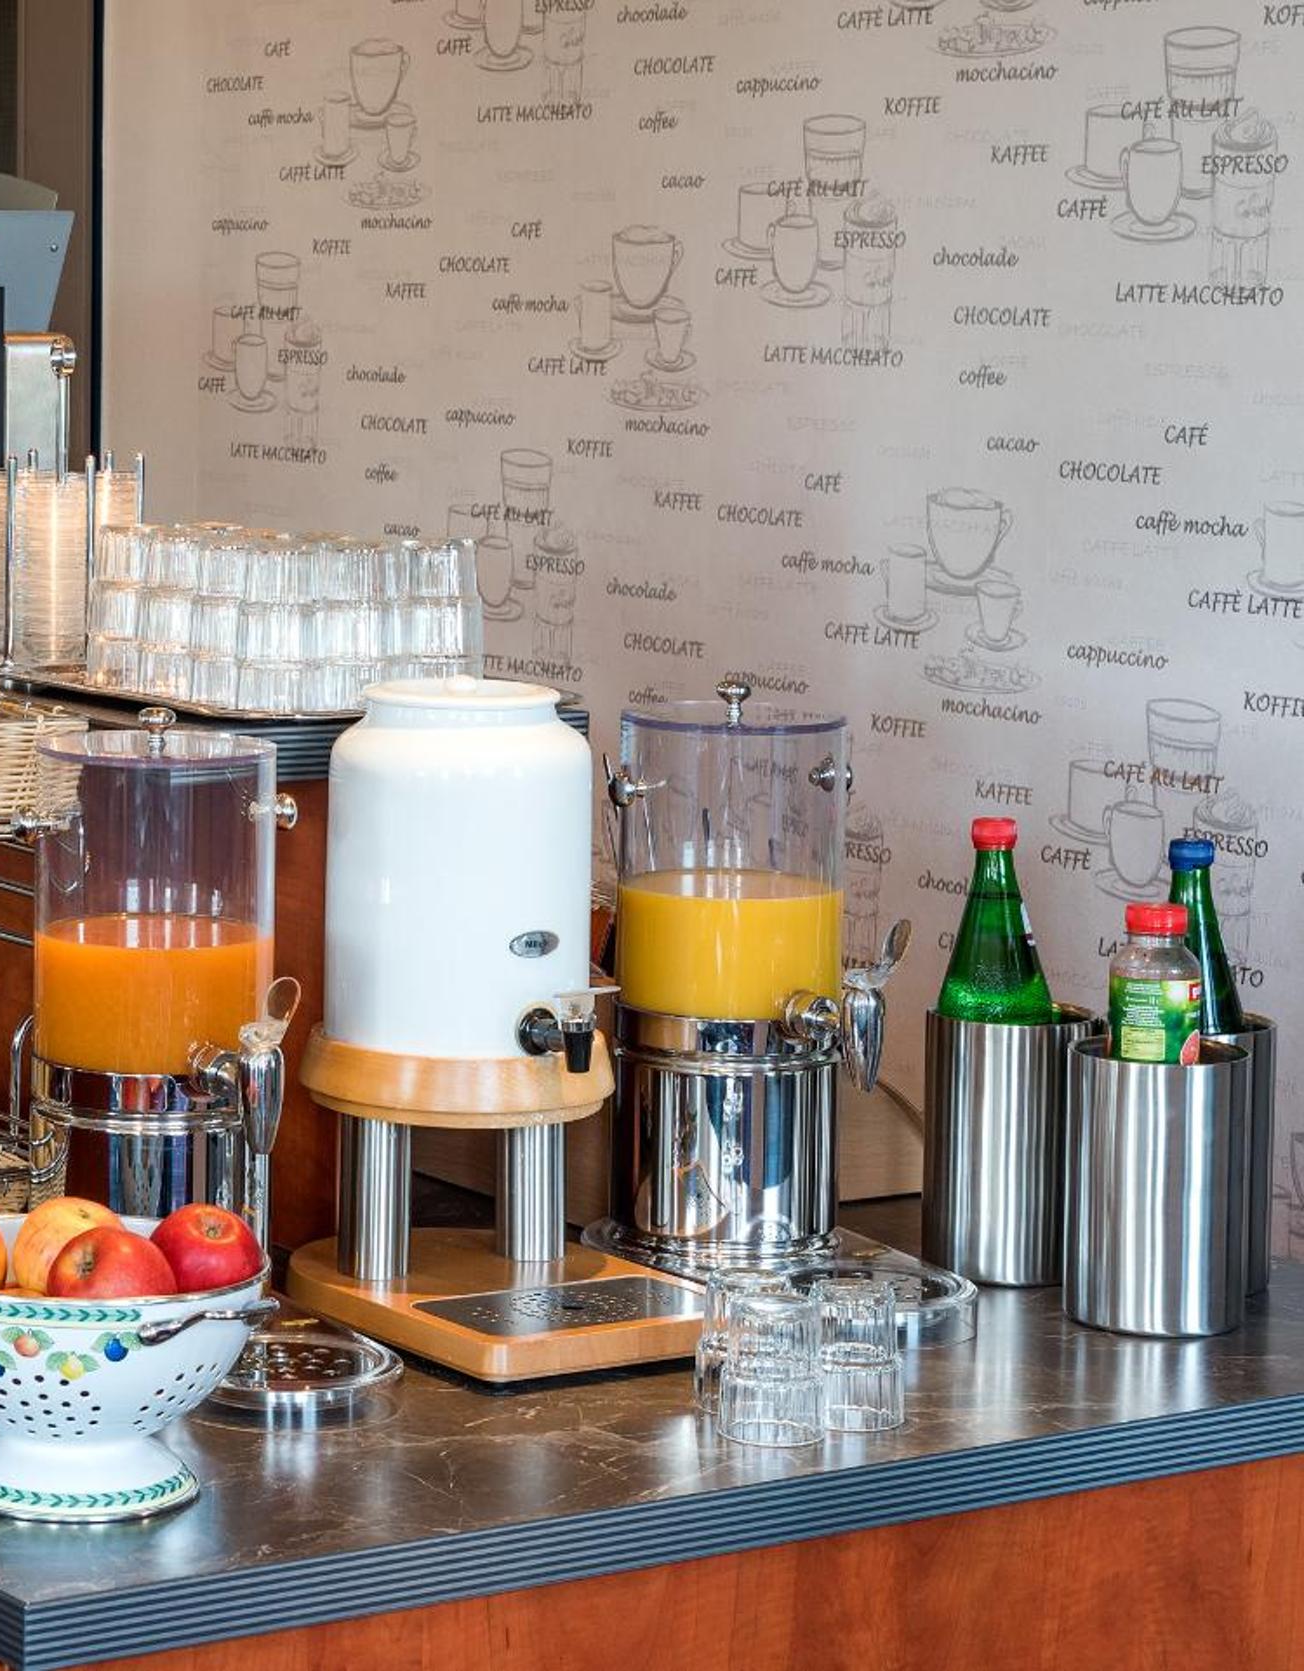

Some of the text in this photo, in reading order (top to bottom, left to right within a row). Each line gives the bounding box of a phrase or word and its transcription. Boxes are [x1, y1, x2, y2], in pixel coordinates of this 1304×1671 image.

[616, 3, 688, 23] chocolade
[887, 7, 934, 27] LATTE
[1264, 5, 1304, 26] KOF
[634, 56, 716, 75] CHOCOLATE
[955, 61, 1058, 83] mocchacino
[206, 76, 264, 93] CHOCOLATE
[736, 74, 821, 98] cappuccino
[477, 102, 593, 122] LATTE MACCHIATO
[884, 96, 941, 116] KOFFIE
[1121, 97, 1243, 120] CAFÉ AU LAIT
[276, 109, 314, 125] mocha
[638, 111, 679, 133] coffee
[990, 145, 1050, 165] KAFFEE
[1201, 154, 1289, 175] ESPRESSO
[313, 165, 346, 182] LATTE
[661, 174, 705, 189] cacao
[767, 178, 802, 198] CAFÉ
[834, 180, 869, 198] LAIT
[1056, 195, 1108, 219] CAFFÈ
[211, 218, 270, 237] cappuccino
[361, 214, 433, 231] mocchacino
[511, 219, 543, 239] CAFÉ
[312, 238, 352, 256] KOFFIE
[834, 230, 907, 249] ESPRESSO
[439, 256, 511, 274] CHOCOLATE
[933, 247, 1019, 268] chocolade
[386, 282, 427, 299] KAFFEE
[1115, 282, 1284, 306] LATTE MACCHIATO
[525, 295, 570, 312] mocha
[954, 305, 1052, 328] CHOCOLATE
[278, 348, 328, 366] ESPRESSO
[569, 357, 607, 376] LATTE
[764, 345, 904, 368] LATTE MACCHIATO
[346, 364, 407, 384] chocolade
[959, 364, 1007, 388] coffee
[361, 414, 428, 434] CHOCOLATE
[445, 407, 516, 428] cappuccino
[625, 416, 710, 437] mocchacino
[986, 436, 1040, 454] cacao
[1164, 423, 1209, 447] CAFÉ
[230, 442, 327, 465] LATTE MACCHIATO
[567, 438, 614, 458] KOFFIE
[365, 462, 399, 485] coffee
[804, 472, 844, 494] CAFÉ
[1059, 460, 1163, 485] CHOCOLATE
[471, 501, 499, 521] CAFÉ
[654, 490, 704, 512] KAFFEE
[717, 504, 803, 528] CHOCOLATE
[1136, 510, 1249, 537] caffè mocha
[384, 523, 420, 538] cacao
[525, 553, 585, 576] ESPRESSO
[821, 555, 875, 576] mocha
[606, 577, 677, 601] chocolade
[1188, 589, 1304, 619] CAFFÈ LATTE
[624, 633, 705, 659] CHOCOLATE
[873, 626, 921, 650] LATTE
[1066, 643, 1169, 670] cappuccino
[507, 656, 584, 682] MACCHIATO
[941, 697, 1042, 725] mocchacino
[1244, 690, 1304, 718] KOFFI
[871, 713, 926, 739] KOFFIE
[1104, 760, 1224, 795] CAFÉ AU LAIT
[975, 779, 1033, 806] KAFFEE
[1041, 844, 1091, 871] CAFFÈ
[918, 870, 969, 895] chocol
